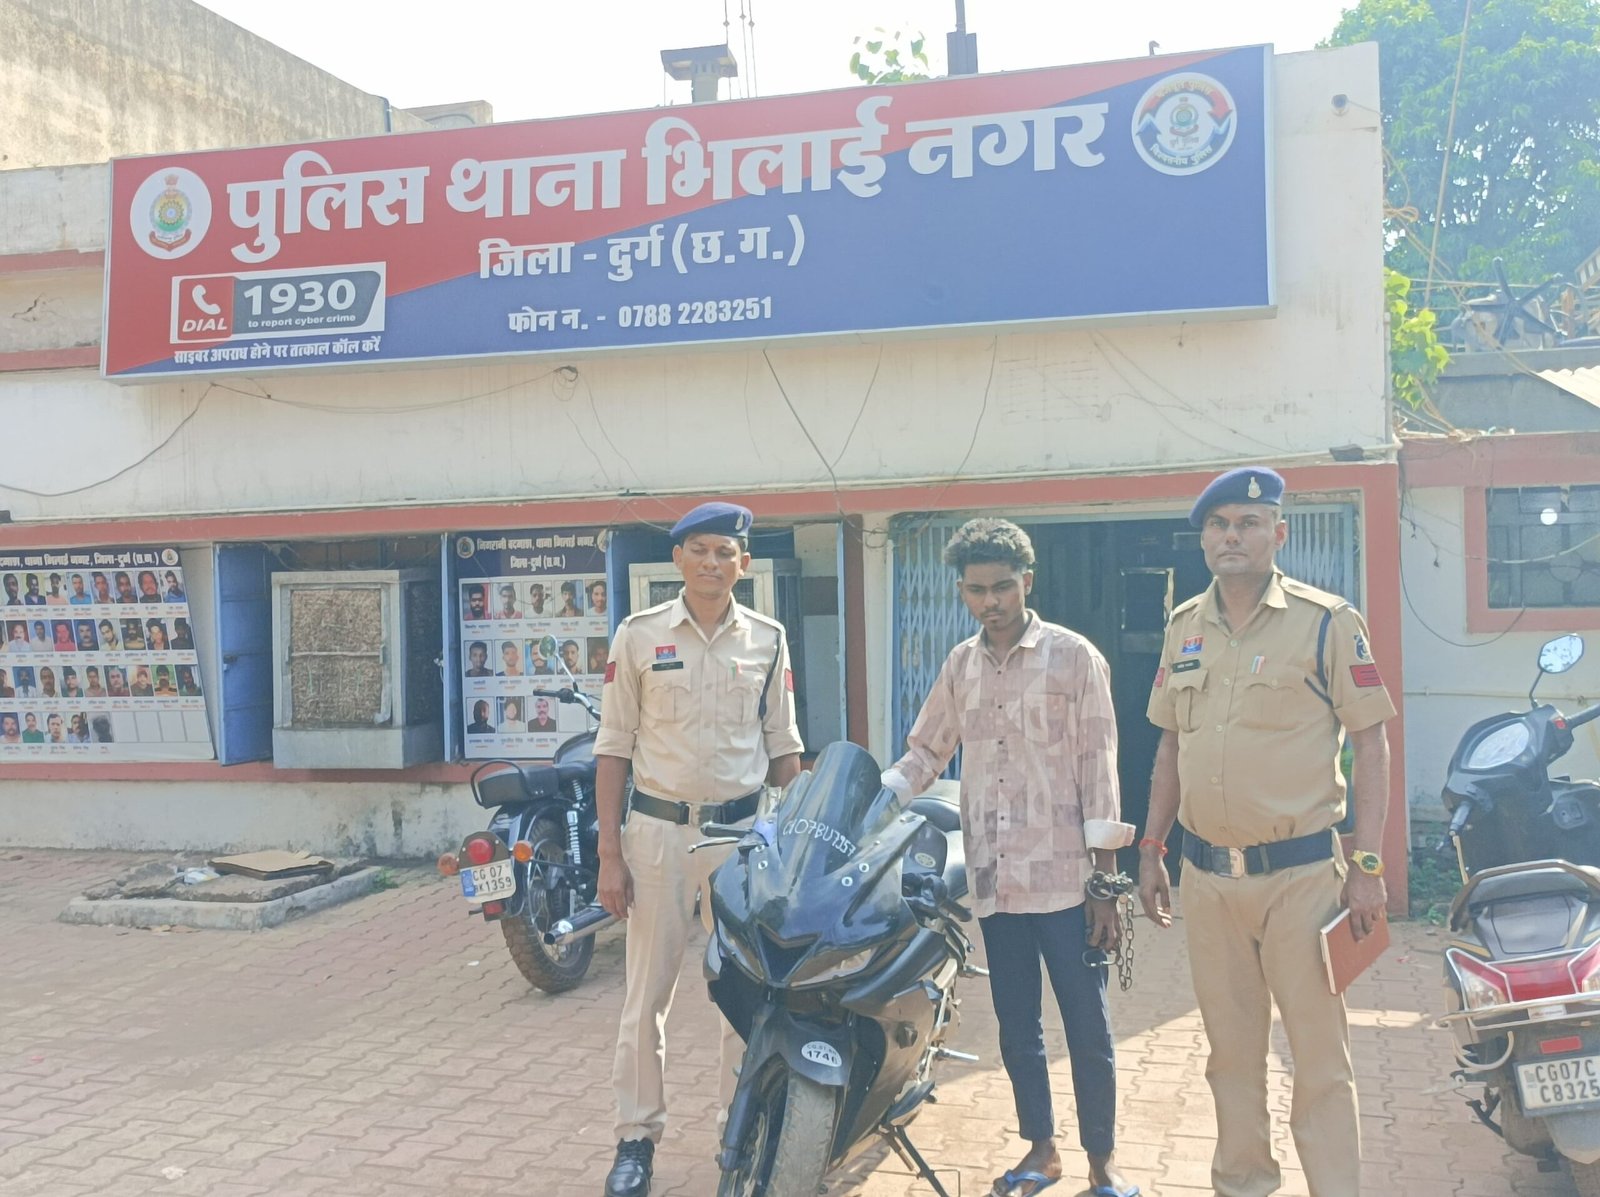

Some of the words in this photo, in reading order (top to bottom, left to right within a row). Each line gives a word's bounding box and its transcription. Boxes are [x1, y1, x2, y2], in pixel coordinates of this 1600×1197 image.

[226, 150, 430, 264] पुलिस
[445, 148, 627, 218] थाना
[641, 95, 893, 206] भिलाई
[905, 102, 1109, 179] नगर
[478, 237, 576, 279] जिला
[606, 223, 665, 282] दुर्ग
[243, 278, 357, 316] 1930
[182, 318, 228, 332] DIAL
[247, 319, 259, 328] to
[260, 318, 293, 328] report
[294, 316, 325, 327] cyber
[326, 314, 356, 323] crime
[507, 305, 558, 333] फोन
[561, 308, 589, 330] न.
[618, 302, 672, 328] 0788
[677, 296, 772, 325] 2283251
[174, 349, 210, 365] साइबर
[210, 348, 248, 362] अपराध
[250, 342, 271, 360] होने
[273, 343, 289, 358] पर
[289, 341, 330, 356] तत्काल
[331, 336, 362, 354] कॉल
[362, 335, 382, 352] करें
[473, 869, 486, 881] CG
[489, 865, 502, 878] 07
[1540, 1079, 1600, 1103] C8325
